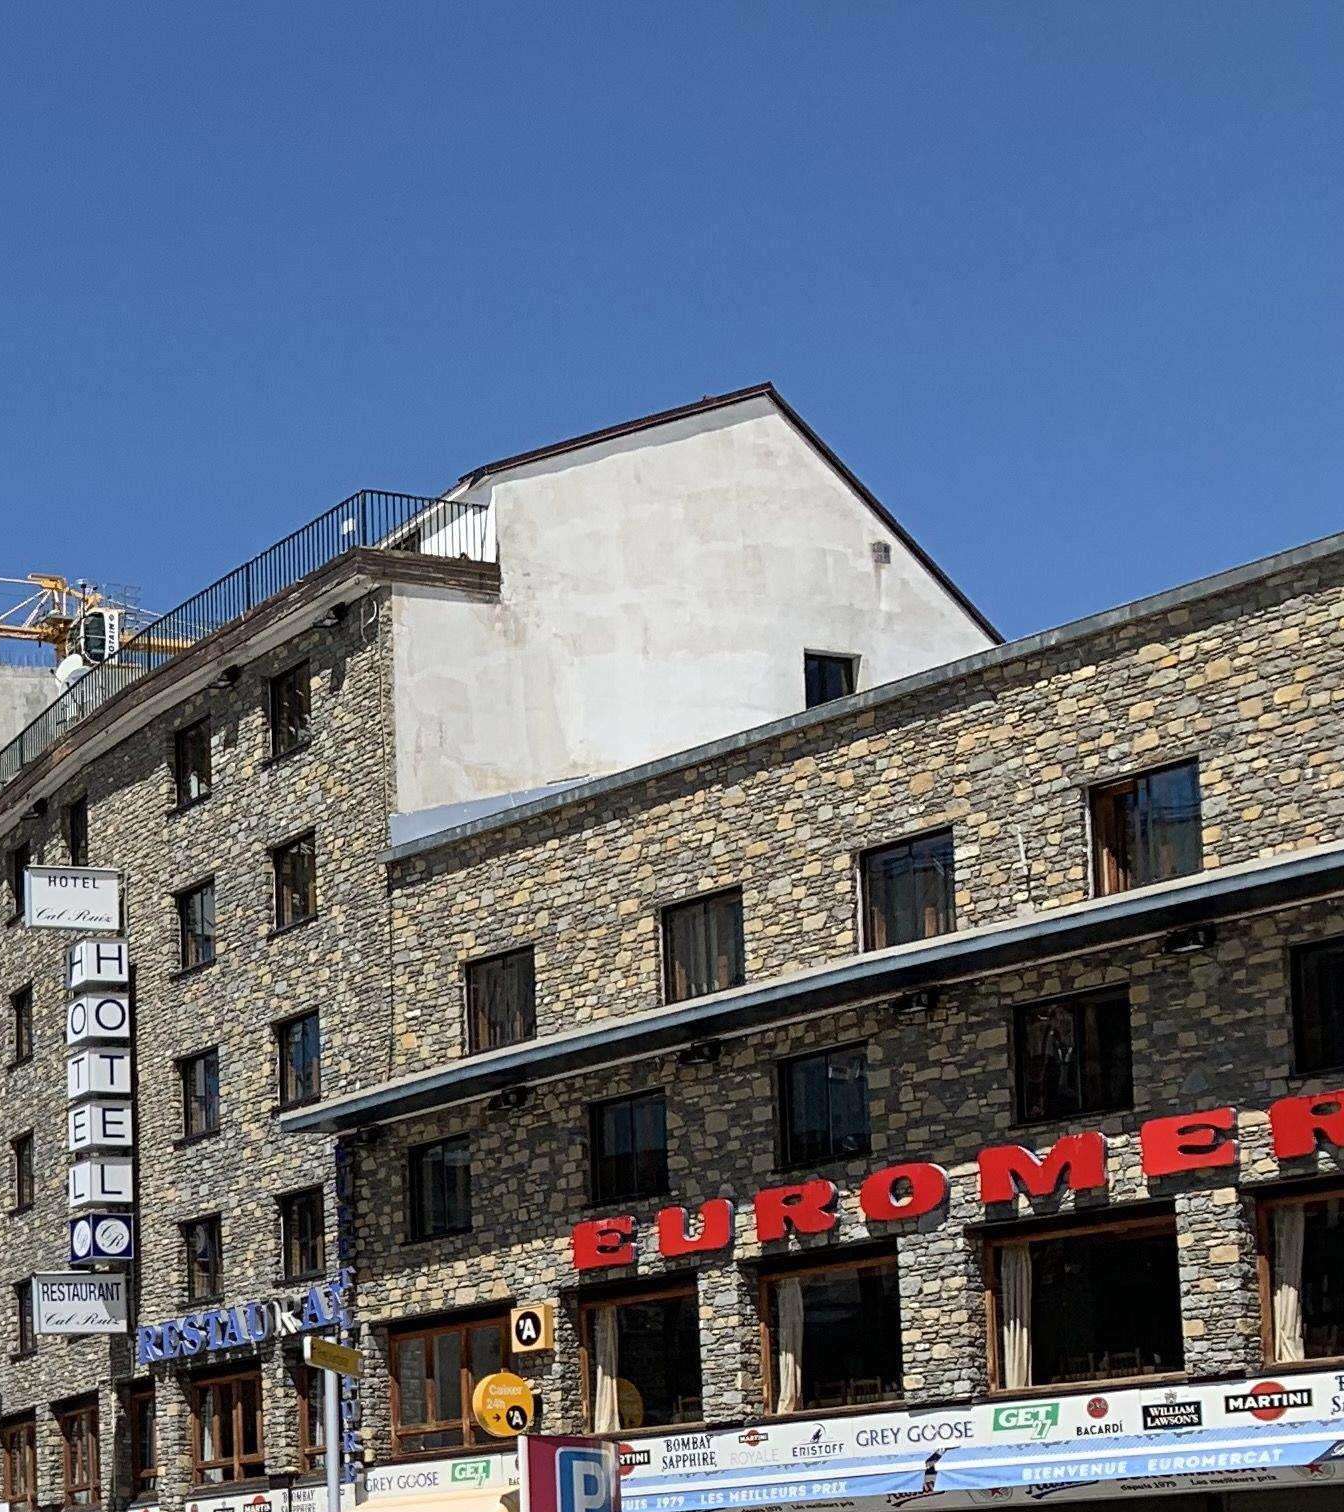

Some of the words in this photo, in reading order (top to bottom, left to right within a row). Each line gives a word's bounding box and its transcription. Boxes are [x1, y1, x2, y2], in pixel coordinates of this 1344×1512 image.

[48, 875, 100, 889] HOTEL
[35, 906, 65, 921] Cal
[95, 943, 126, 1195] HOTEL
[41, 1282, 122, 1302] RESTAURANT
[43, 1311, 74, 1326] Cal
[1148, 1405, 1196, 1417] WILLIAM
[1229, 1391, 1309, 1411] MARTINI
[998, 1406, 1052, 1428] GET
[1146, 1414, 1200, 1428] LAWSON'S
[664, 1434, 714, 1453] BOMBAY
[856, 1427, 900, 1447] GREY
[906, 1421, 975, 1444] GOOSE
[730, 1448, 779, 1465] ROYALE
[792, 1443, 845, 1458] ERISTOFF
[660, 1451, 718, 1472] SAPPHIRE
[1022, 1461, 1129, 1481] BIENVENUE
[1147, 1448, 1284, 1472] EUROMERCAT
[364, 1476, 393, 1493] GREY
[397, 1471, 440, 1490] GOOSE
[656, 1496, 686, 1509] 1979
[700, 1493, 724, 1505] LES
[729, 1485, 807, 1503] MEILLEURS
[812, 1482, 848, 1496] PRIX
